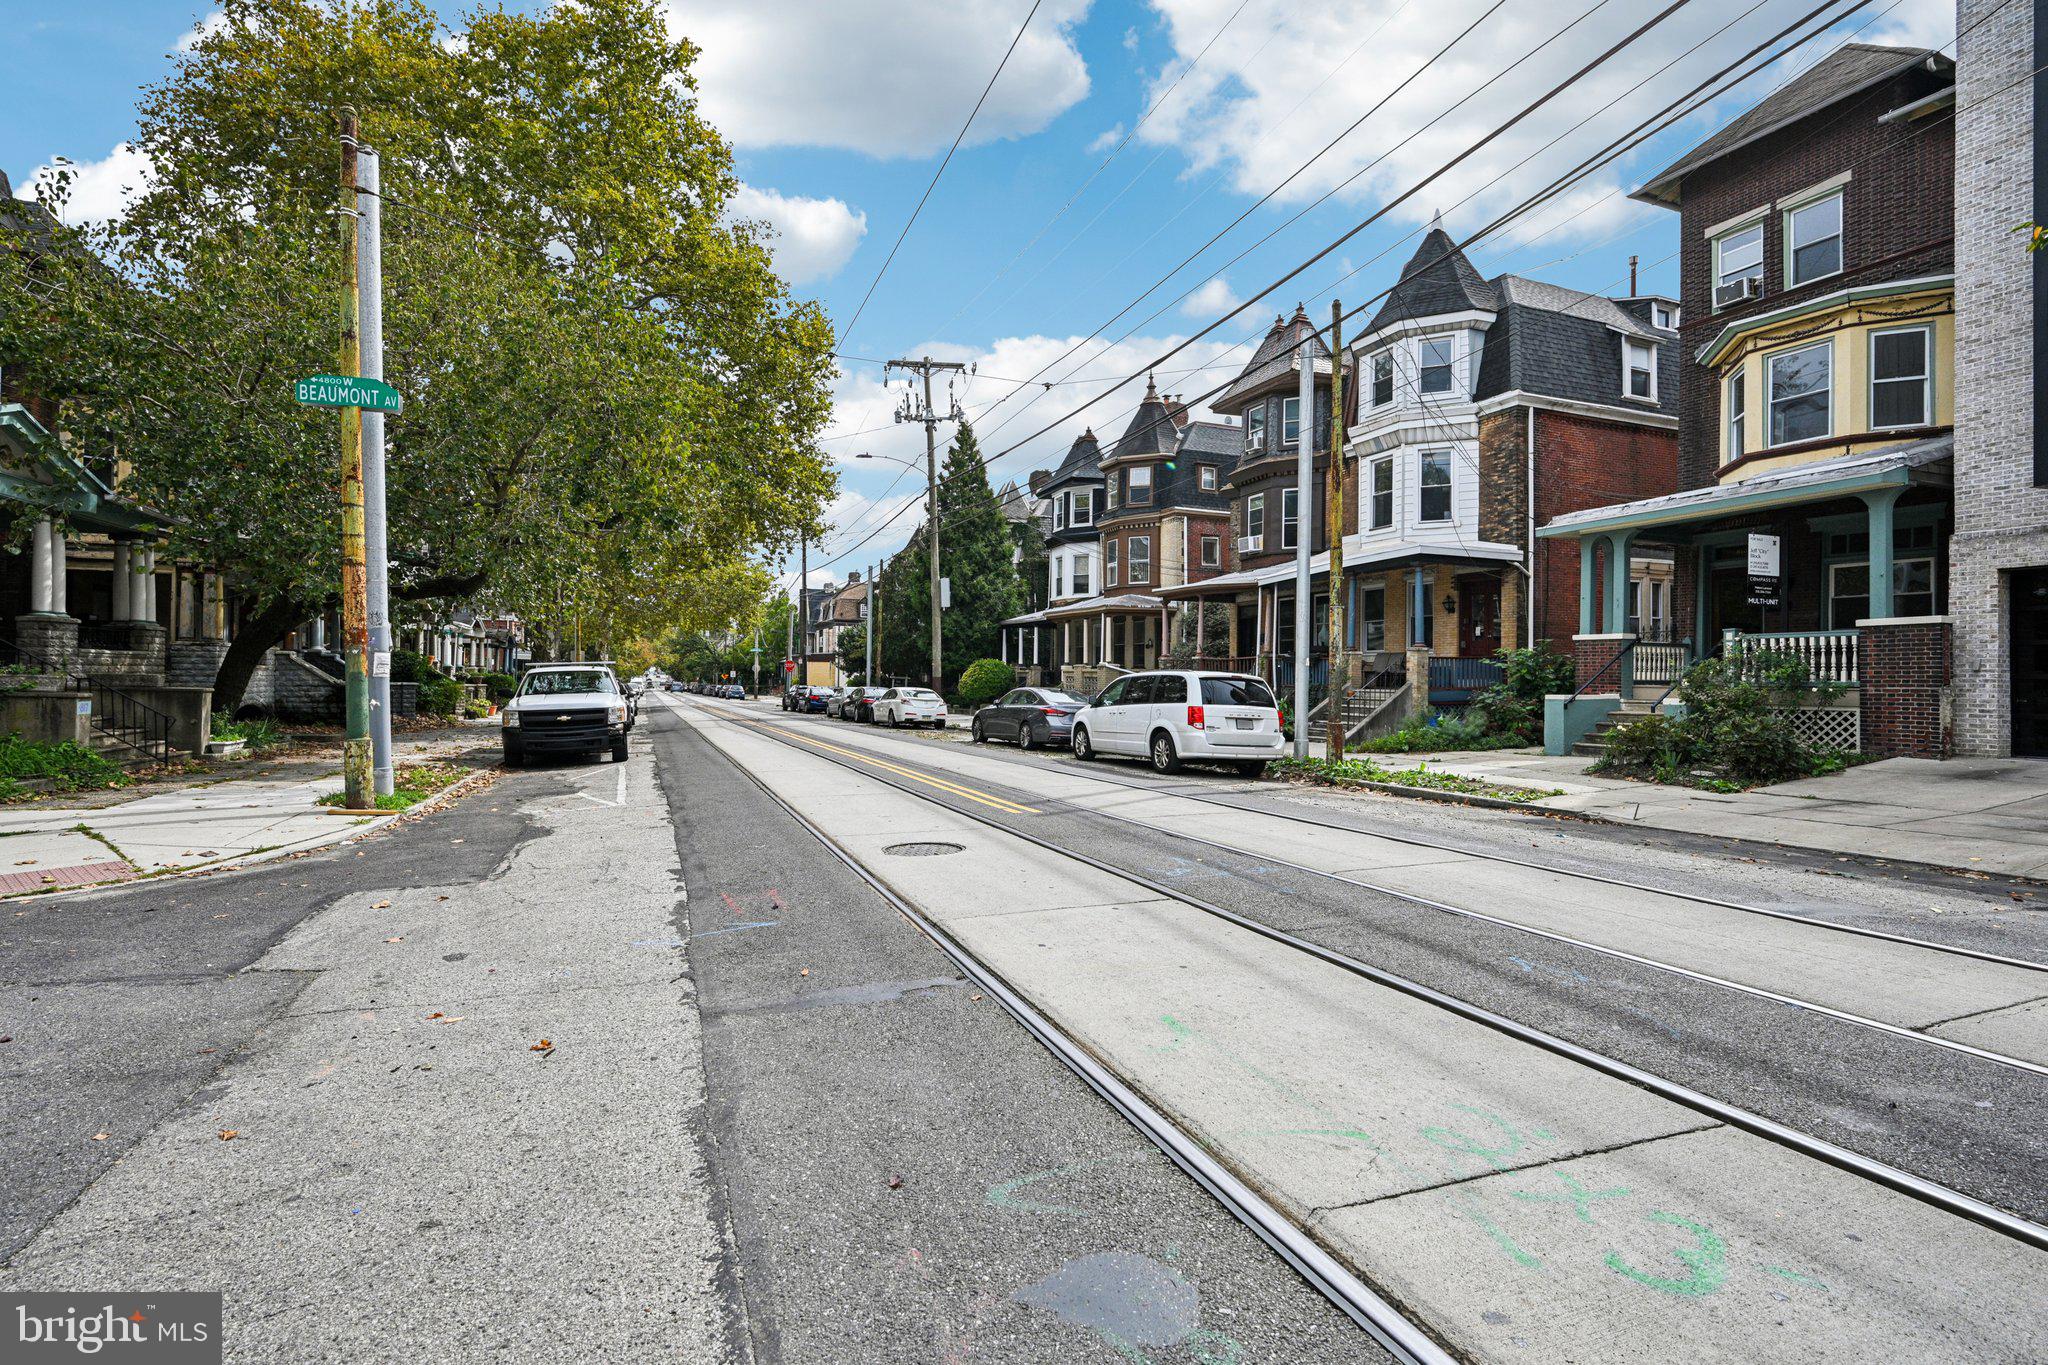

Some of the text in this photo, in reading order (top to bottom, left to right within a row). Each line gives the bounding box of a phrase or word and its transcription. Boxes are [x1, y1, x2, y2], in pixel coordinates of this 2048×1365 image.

[343, 377, 353, 386] W
[299, 384, 397, 407] BEAUMONT AV
[1748, 597, 1778, 605] MULTI-UNIT
